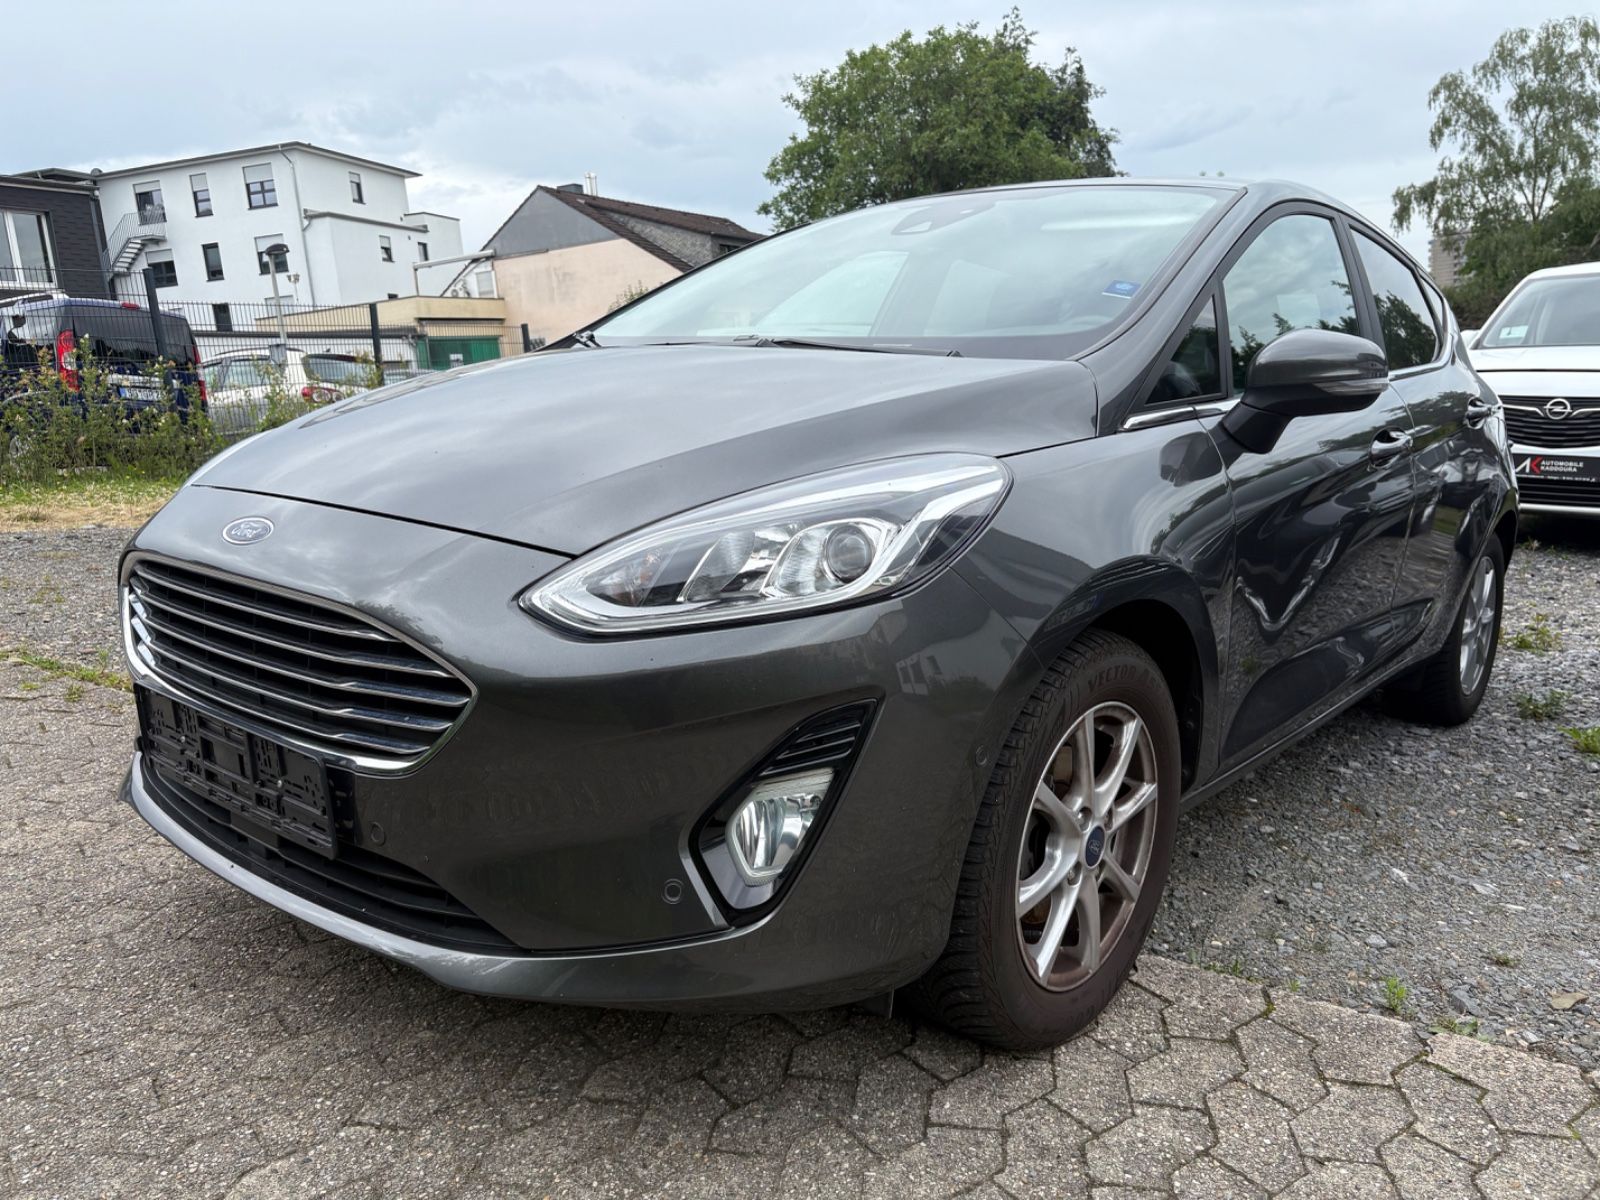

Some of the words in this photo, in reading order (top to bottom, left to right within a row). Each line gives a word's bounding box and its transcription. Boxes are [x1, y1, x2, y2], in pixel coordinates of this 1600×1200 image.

[1541, 460, 1584, 468] AUTOMOBILE
[231, 521, 264, 539] Ford
[1087, 663, 1137, 693] VECTOR
